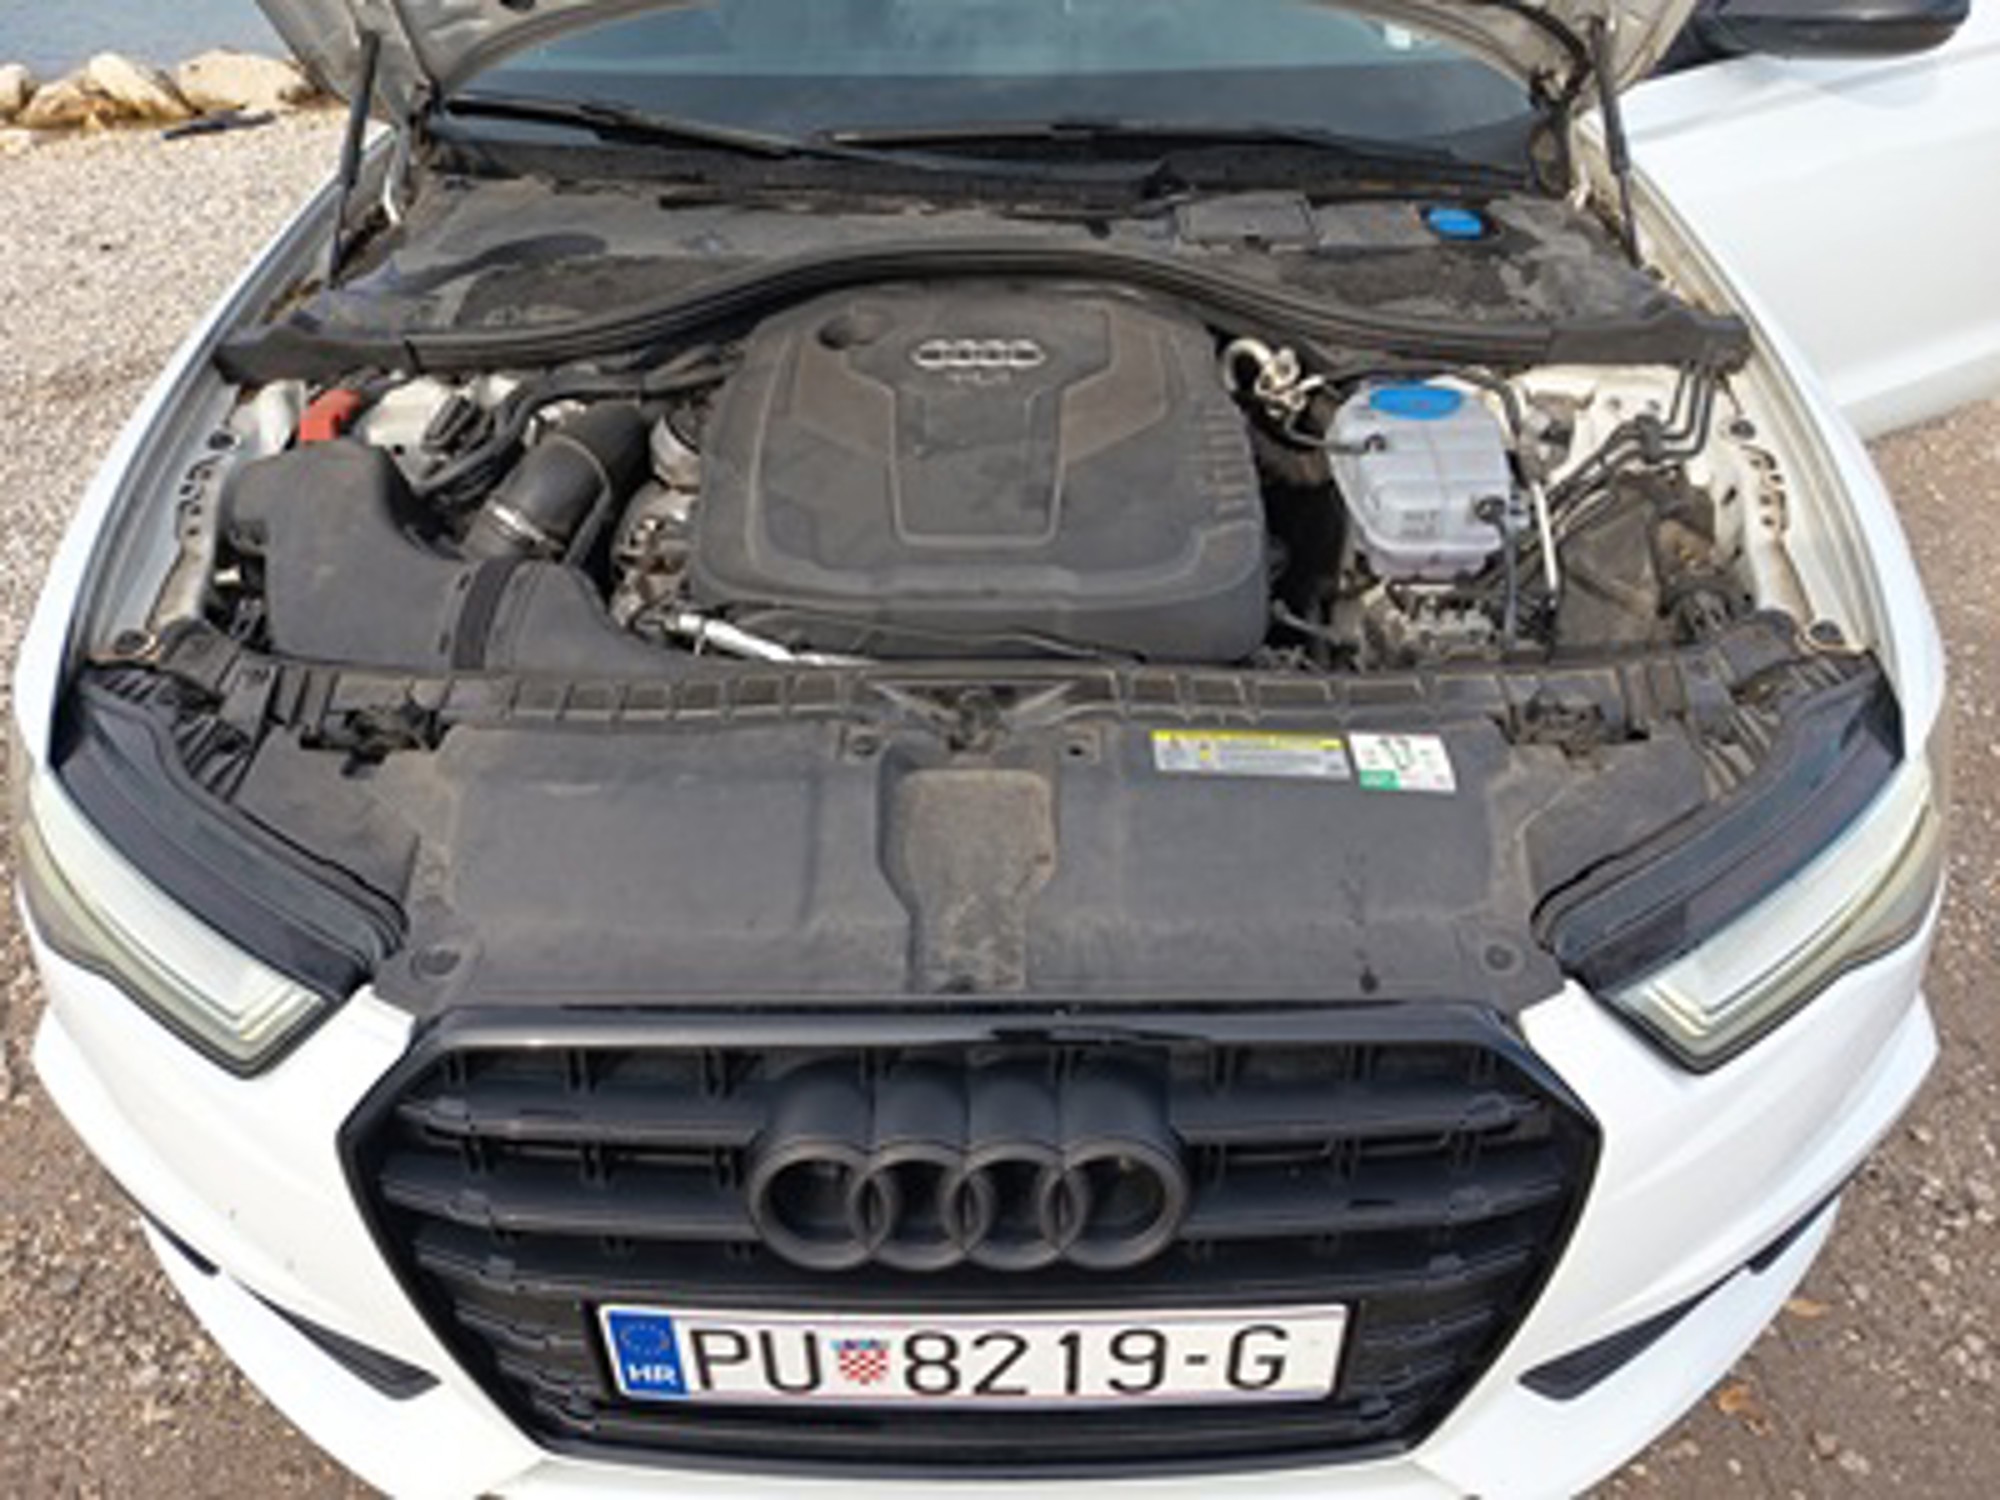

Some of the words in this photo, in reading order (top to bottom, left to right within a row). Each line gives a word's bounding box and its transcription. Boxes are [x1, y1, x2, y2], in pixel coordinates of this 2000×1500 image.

[628, 1365, 677, 1388] HR
[689, 1328, 824, 1394] PU
[902, 1324, 1289, 1396] 8219-G
